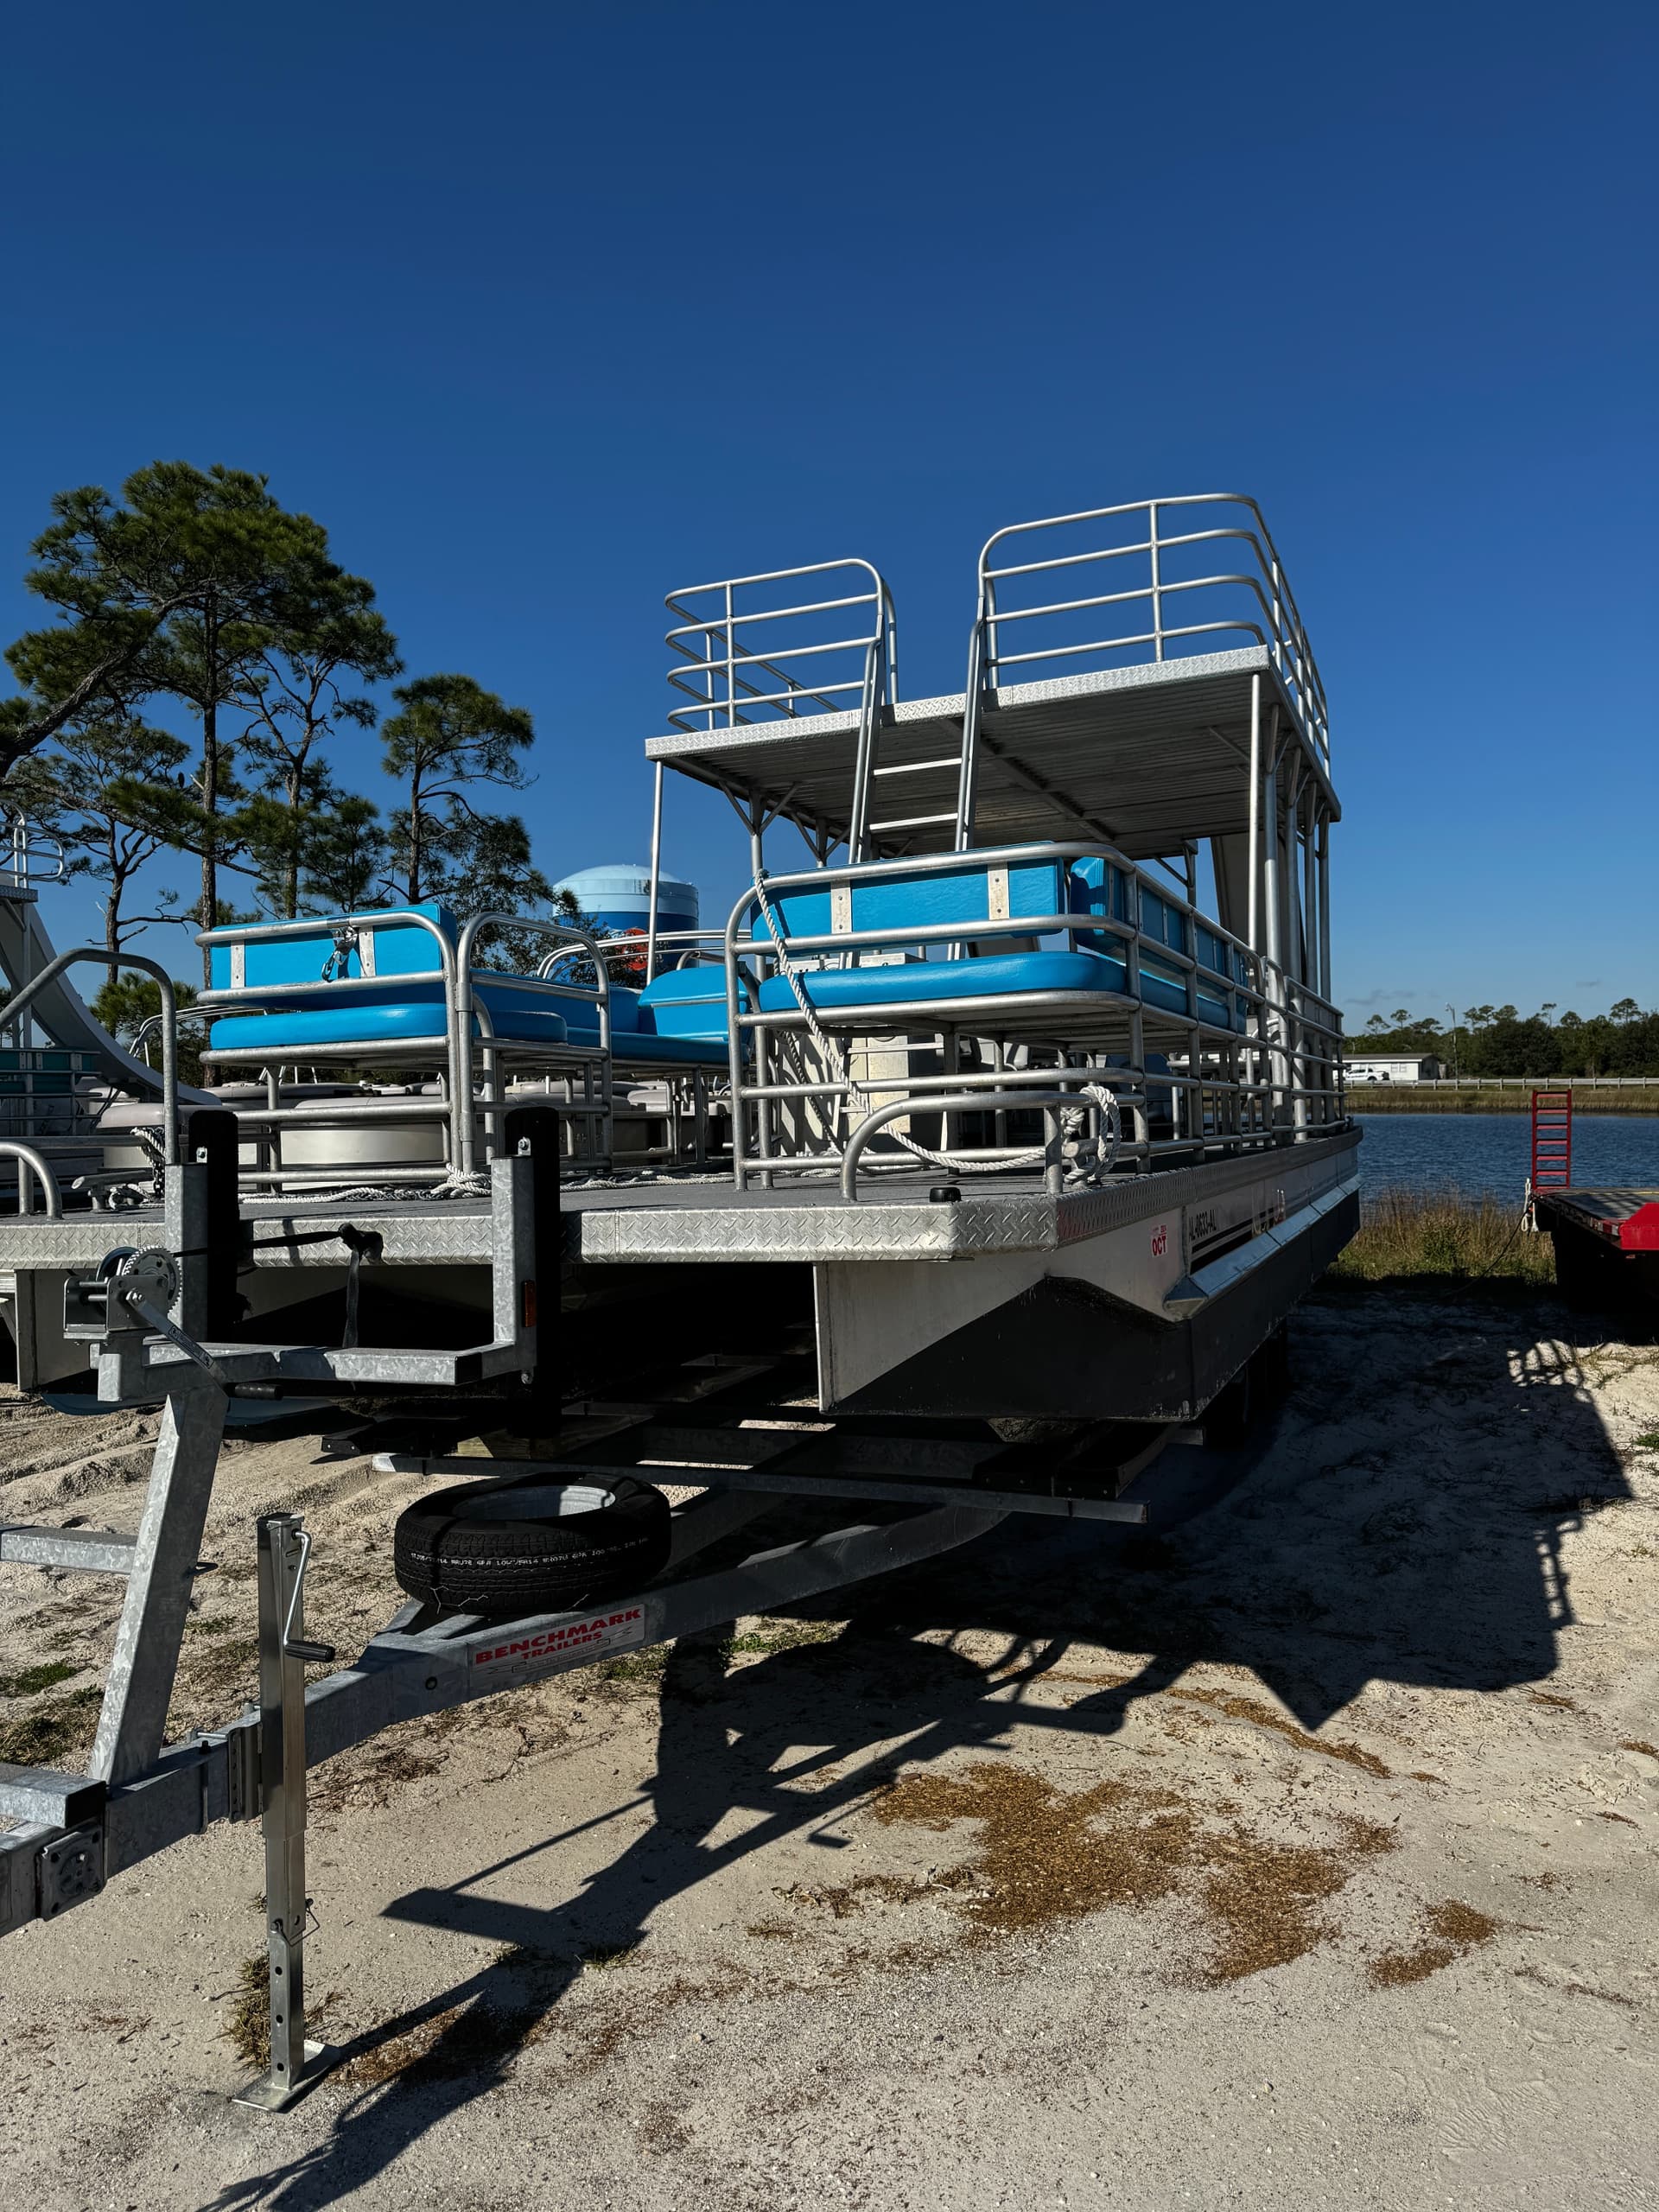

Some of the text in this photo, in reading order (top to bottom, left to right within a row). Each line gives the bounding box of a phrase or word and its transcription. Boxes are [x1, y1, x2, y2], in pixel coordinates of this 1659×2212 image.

[1152, 1236, 1166, 1256] OCT
[475, 1608, 641, 1665] BENCHMARK
[520, 1631, 602, 1660] TRAILERS
